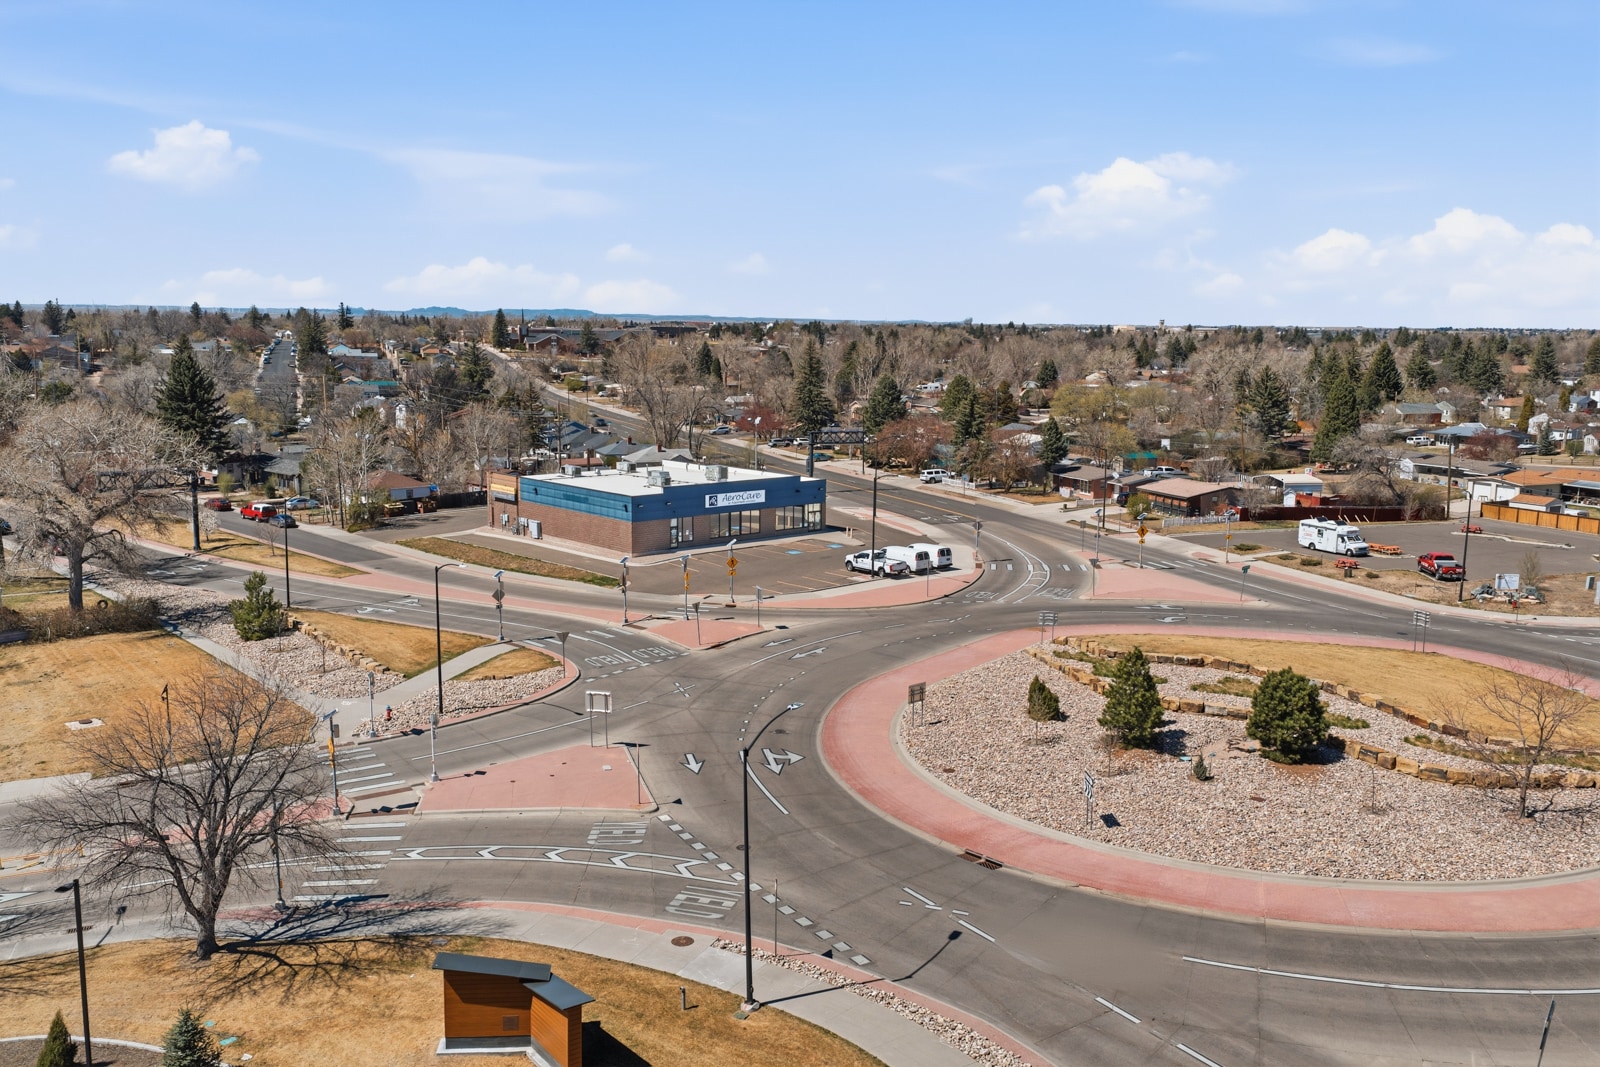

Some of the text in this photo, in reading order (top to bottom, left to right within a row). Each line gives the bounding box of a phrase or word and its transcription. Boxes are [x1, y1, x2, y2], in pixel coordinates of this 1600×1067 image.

[722, 491, 761, 502] AeroCare
[632, 646, 680, 659] YIELD
[585, 654, 634, 668] YIELD
[586, 821, 649, 845] YIELD
[665, 885, 745, 919] YIELD
